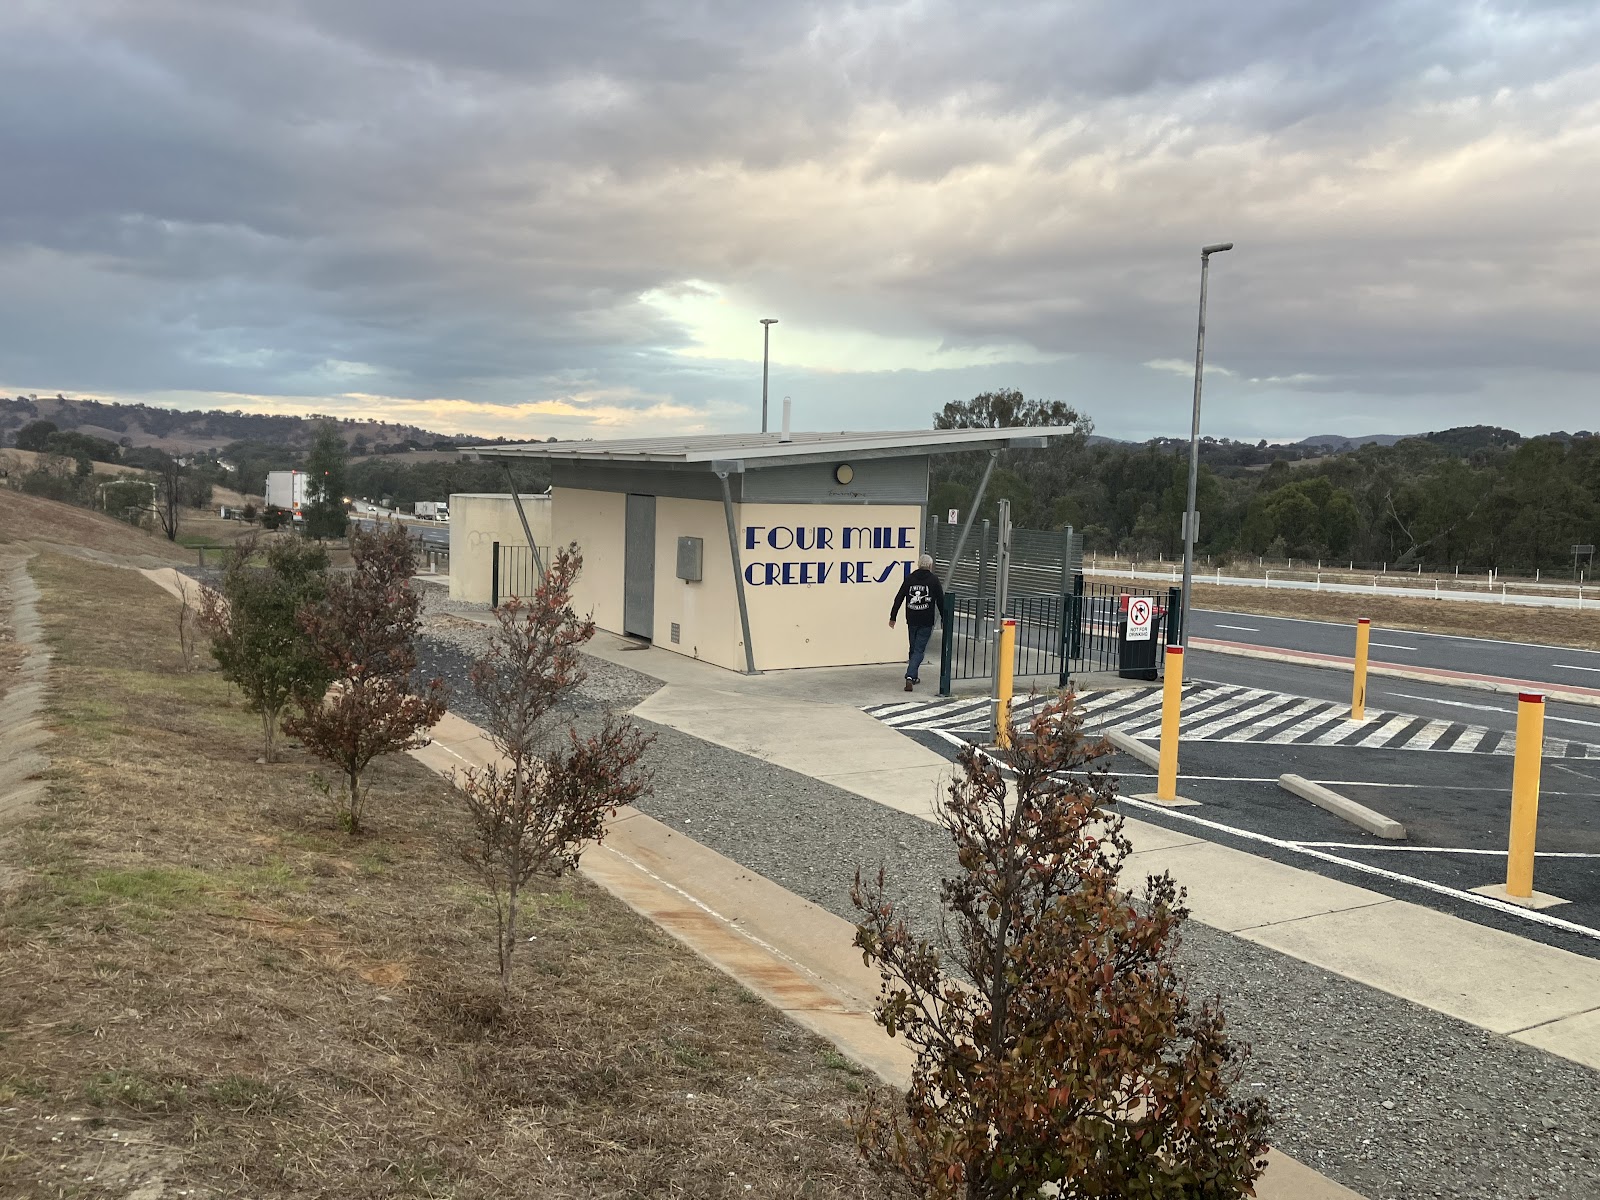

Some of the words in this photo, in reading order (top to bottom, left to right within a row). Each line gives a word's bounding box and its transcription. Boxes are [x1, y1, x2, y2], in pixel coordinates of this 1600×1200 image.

[745, 526, 833, 550] FOUR
[842, 527, 916, 549] MILE
[840, 560, 915, 584] REST
